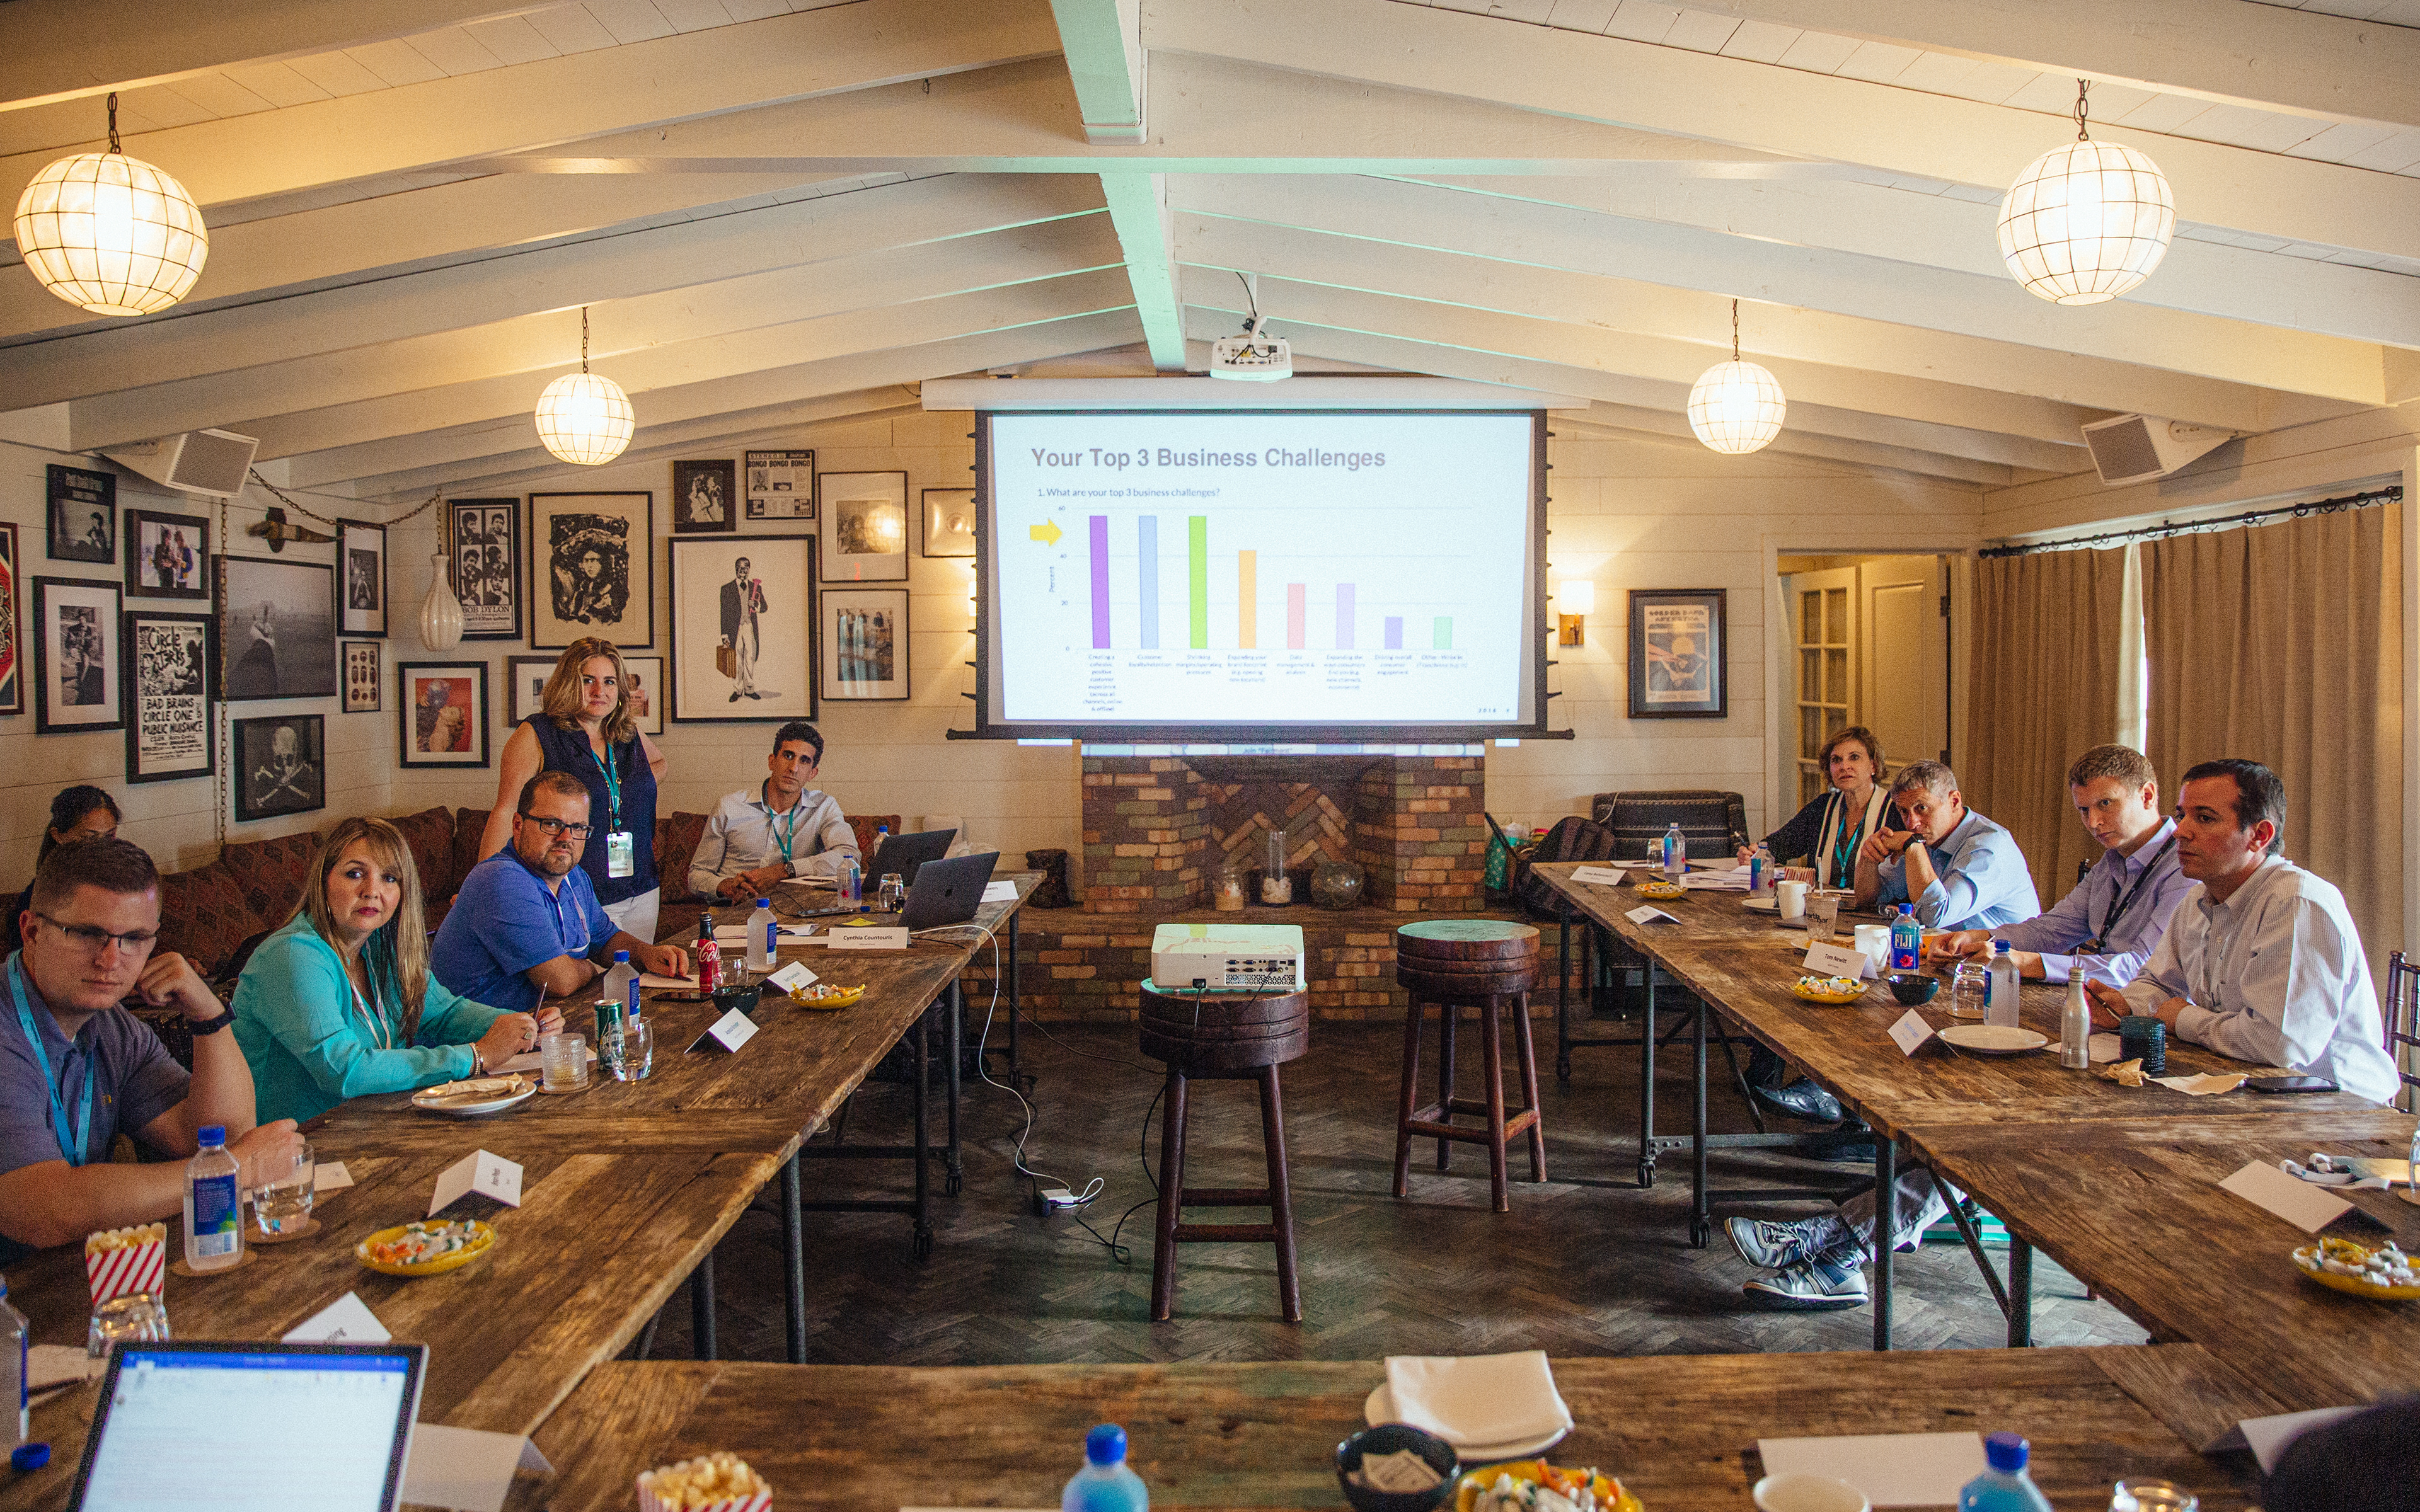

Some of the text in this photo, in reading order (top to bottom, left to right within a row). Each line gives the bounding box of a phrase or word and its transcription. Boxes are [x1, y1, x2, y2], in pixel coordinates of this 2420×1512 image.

[1032, 448, 1385, 471] Your Top 3 Business Challenges
[1037, 488, 1045, 497] 1.
[1047, 488, 1070, 497] What
[1088, 490, 1107, 499] your
[1109, 489, 1124, 498] top
[1126, 488, 1132, 497] 3
[1133, 488, 1170, 497] business
[1171, 488, 1221, 498] challenges?
[146, 697, 195, 710] BAD BRAINS
[143, 710, 171, 723] CIRCLE
[173, 709, 194, 722] ONE
[142, 720, 204, 736] PUBLIC NUISANCE
[1894, 934, 1913, 948] FIJI
[1834, 955, 1847, 964] Newitt
